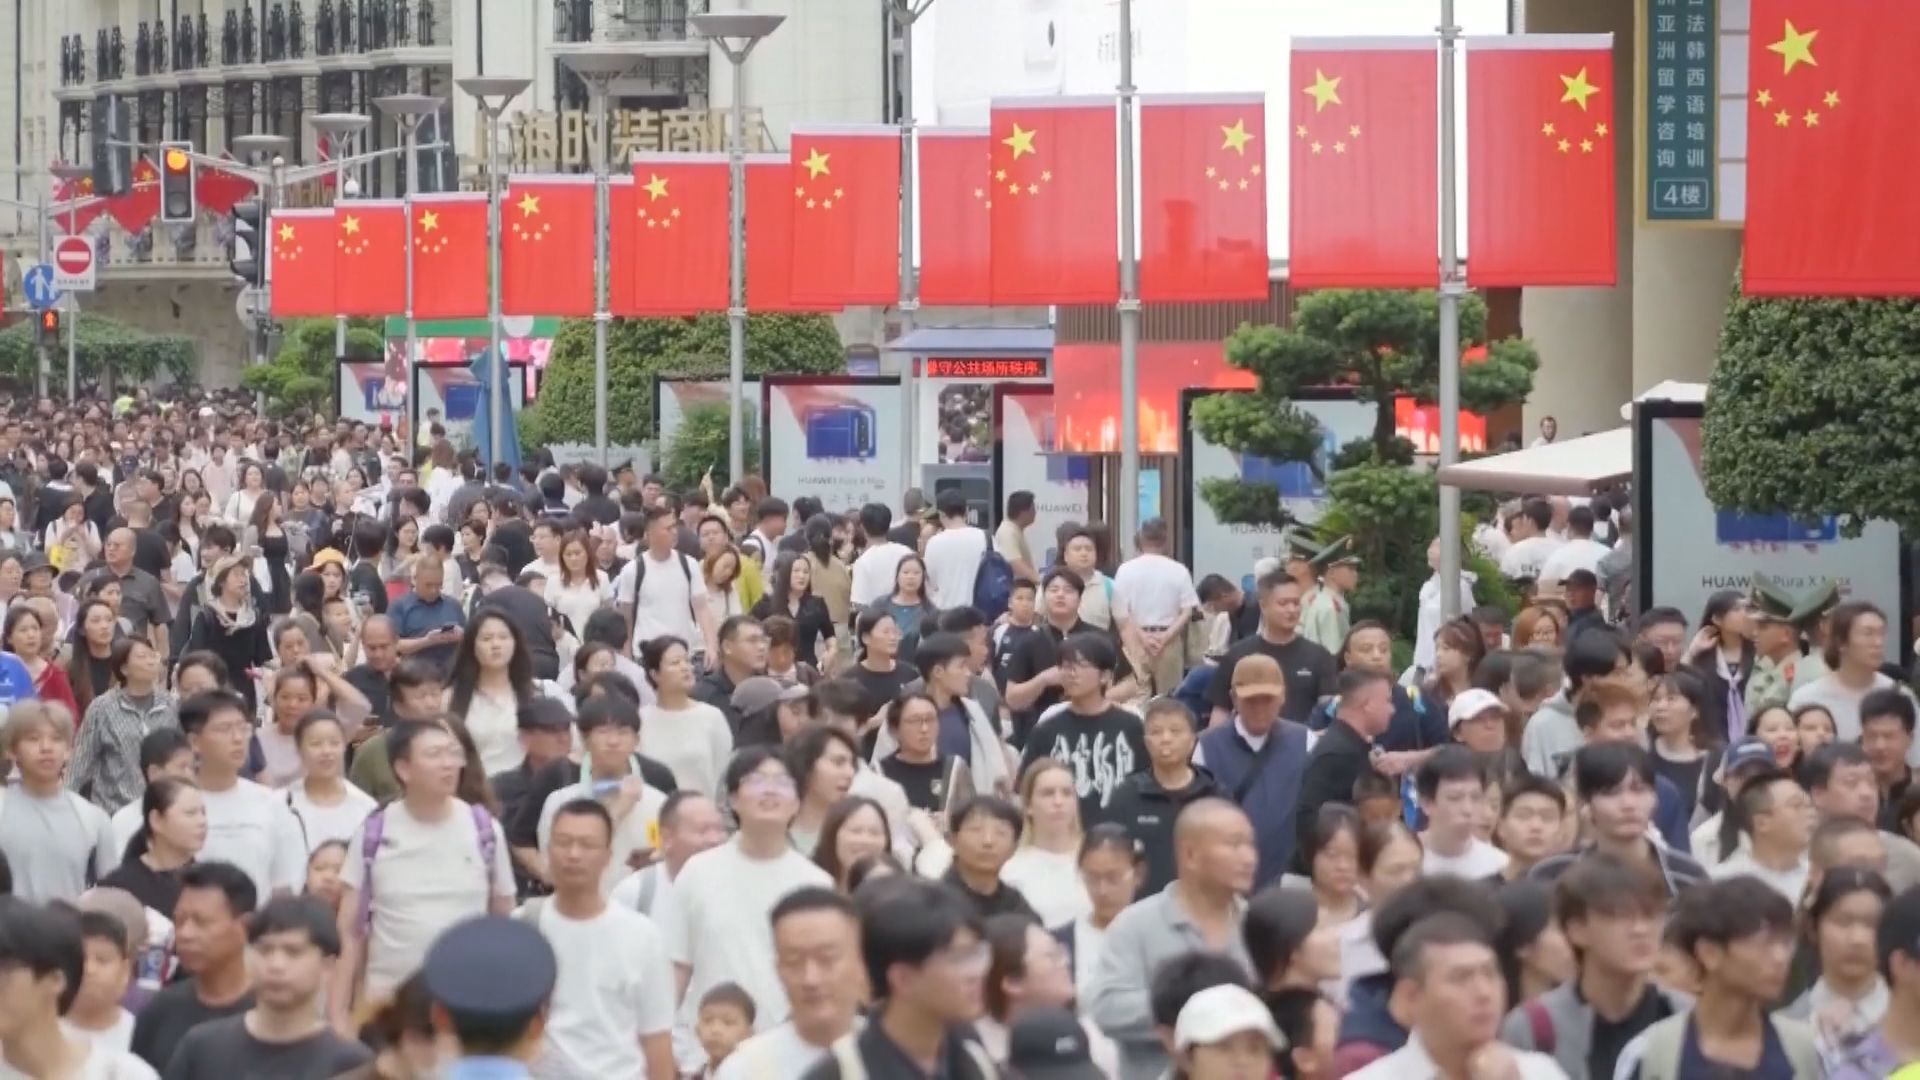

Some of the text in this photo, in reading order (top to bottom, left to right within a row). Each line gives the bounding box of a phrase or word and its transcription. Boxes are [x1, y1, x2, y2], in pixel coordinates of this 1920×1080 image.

[1656, 0, 1676, 168] 亚洲留学咨询
[1685, 0, 1705, 168] 法韩西语培训
[1663, 184, 1701, 206] 4楼
[1230, 524, 1279, 535] HUAWE
[1702, 575, 1752, 588] HUAW
[1771, 575, 1804, 587] Pura
[1808, 575, 1817, 586] X
